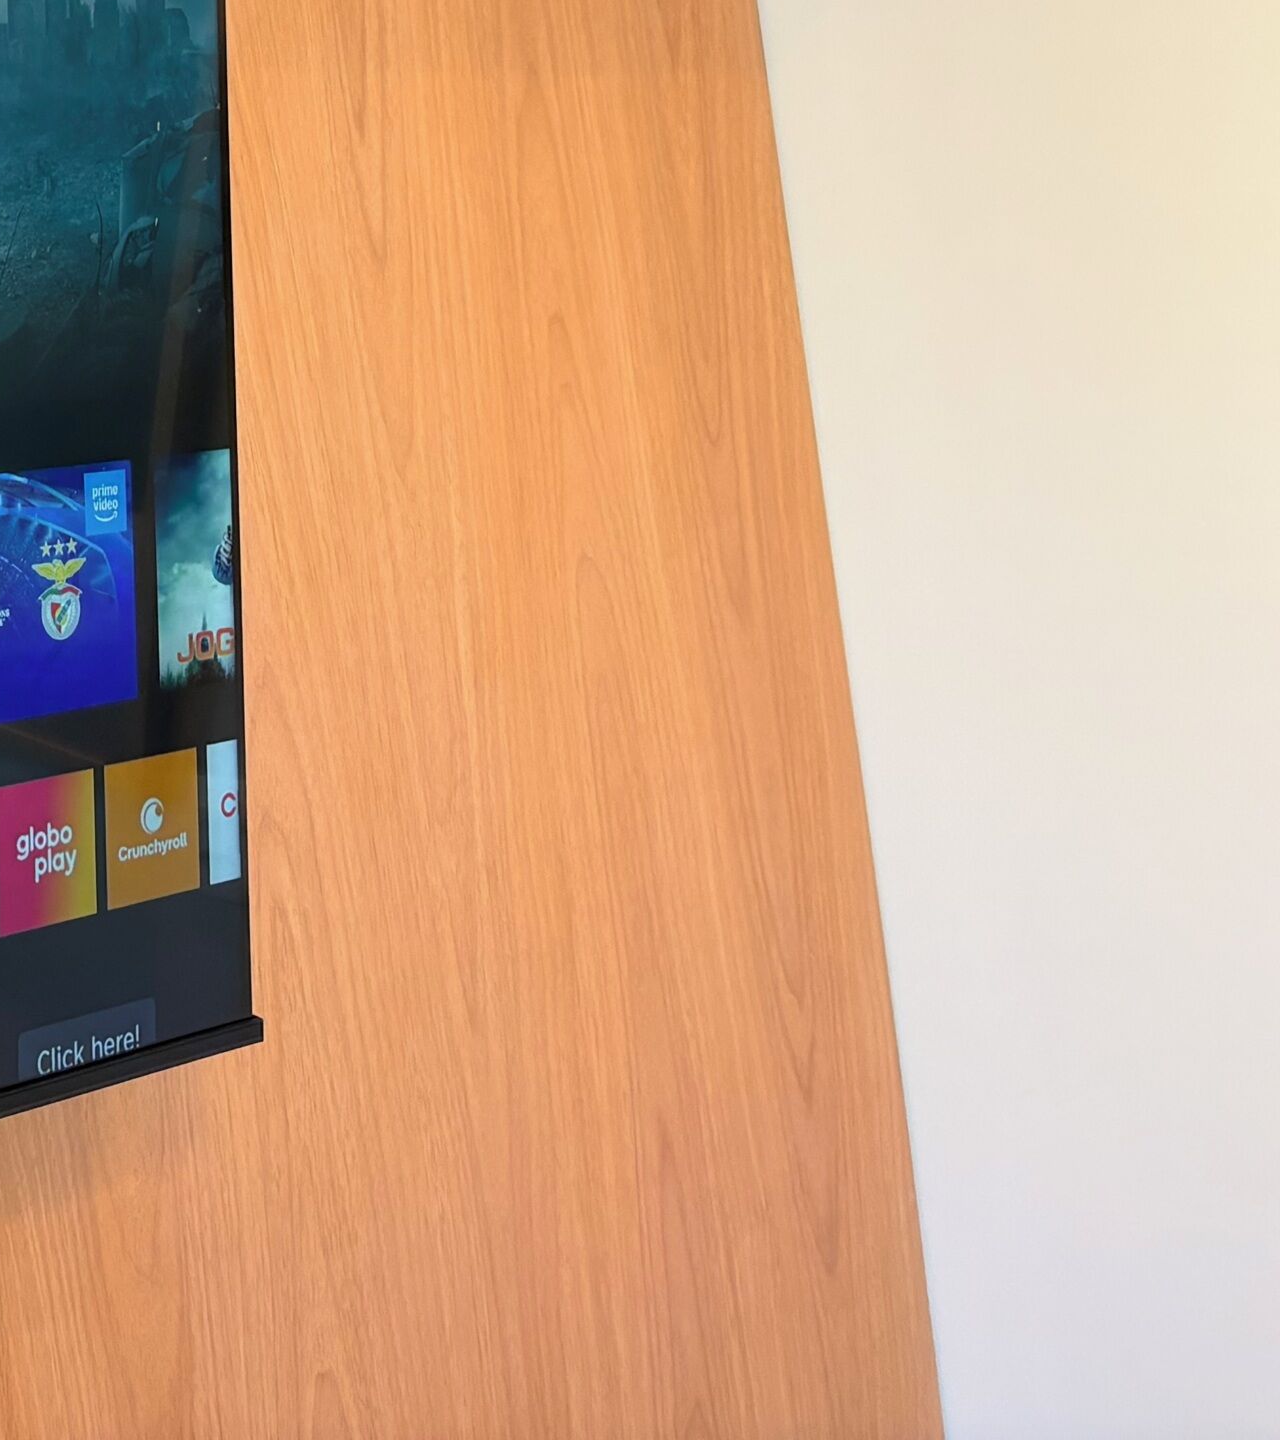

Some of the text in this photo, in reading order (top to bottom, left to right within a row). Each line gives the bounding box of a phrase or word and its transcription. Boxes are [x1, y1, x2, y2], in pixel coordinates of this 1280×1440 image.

[92, 484, 118, 500] prime
[93, 497, 119, 511] video
[16, 823, 73, 860] globo
[118, 831, 188, 862] Crunchyroll
[34, 846, 78, 883] play
[37, 1024, 141, 1076] Click here!
